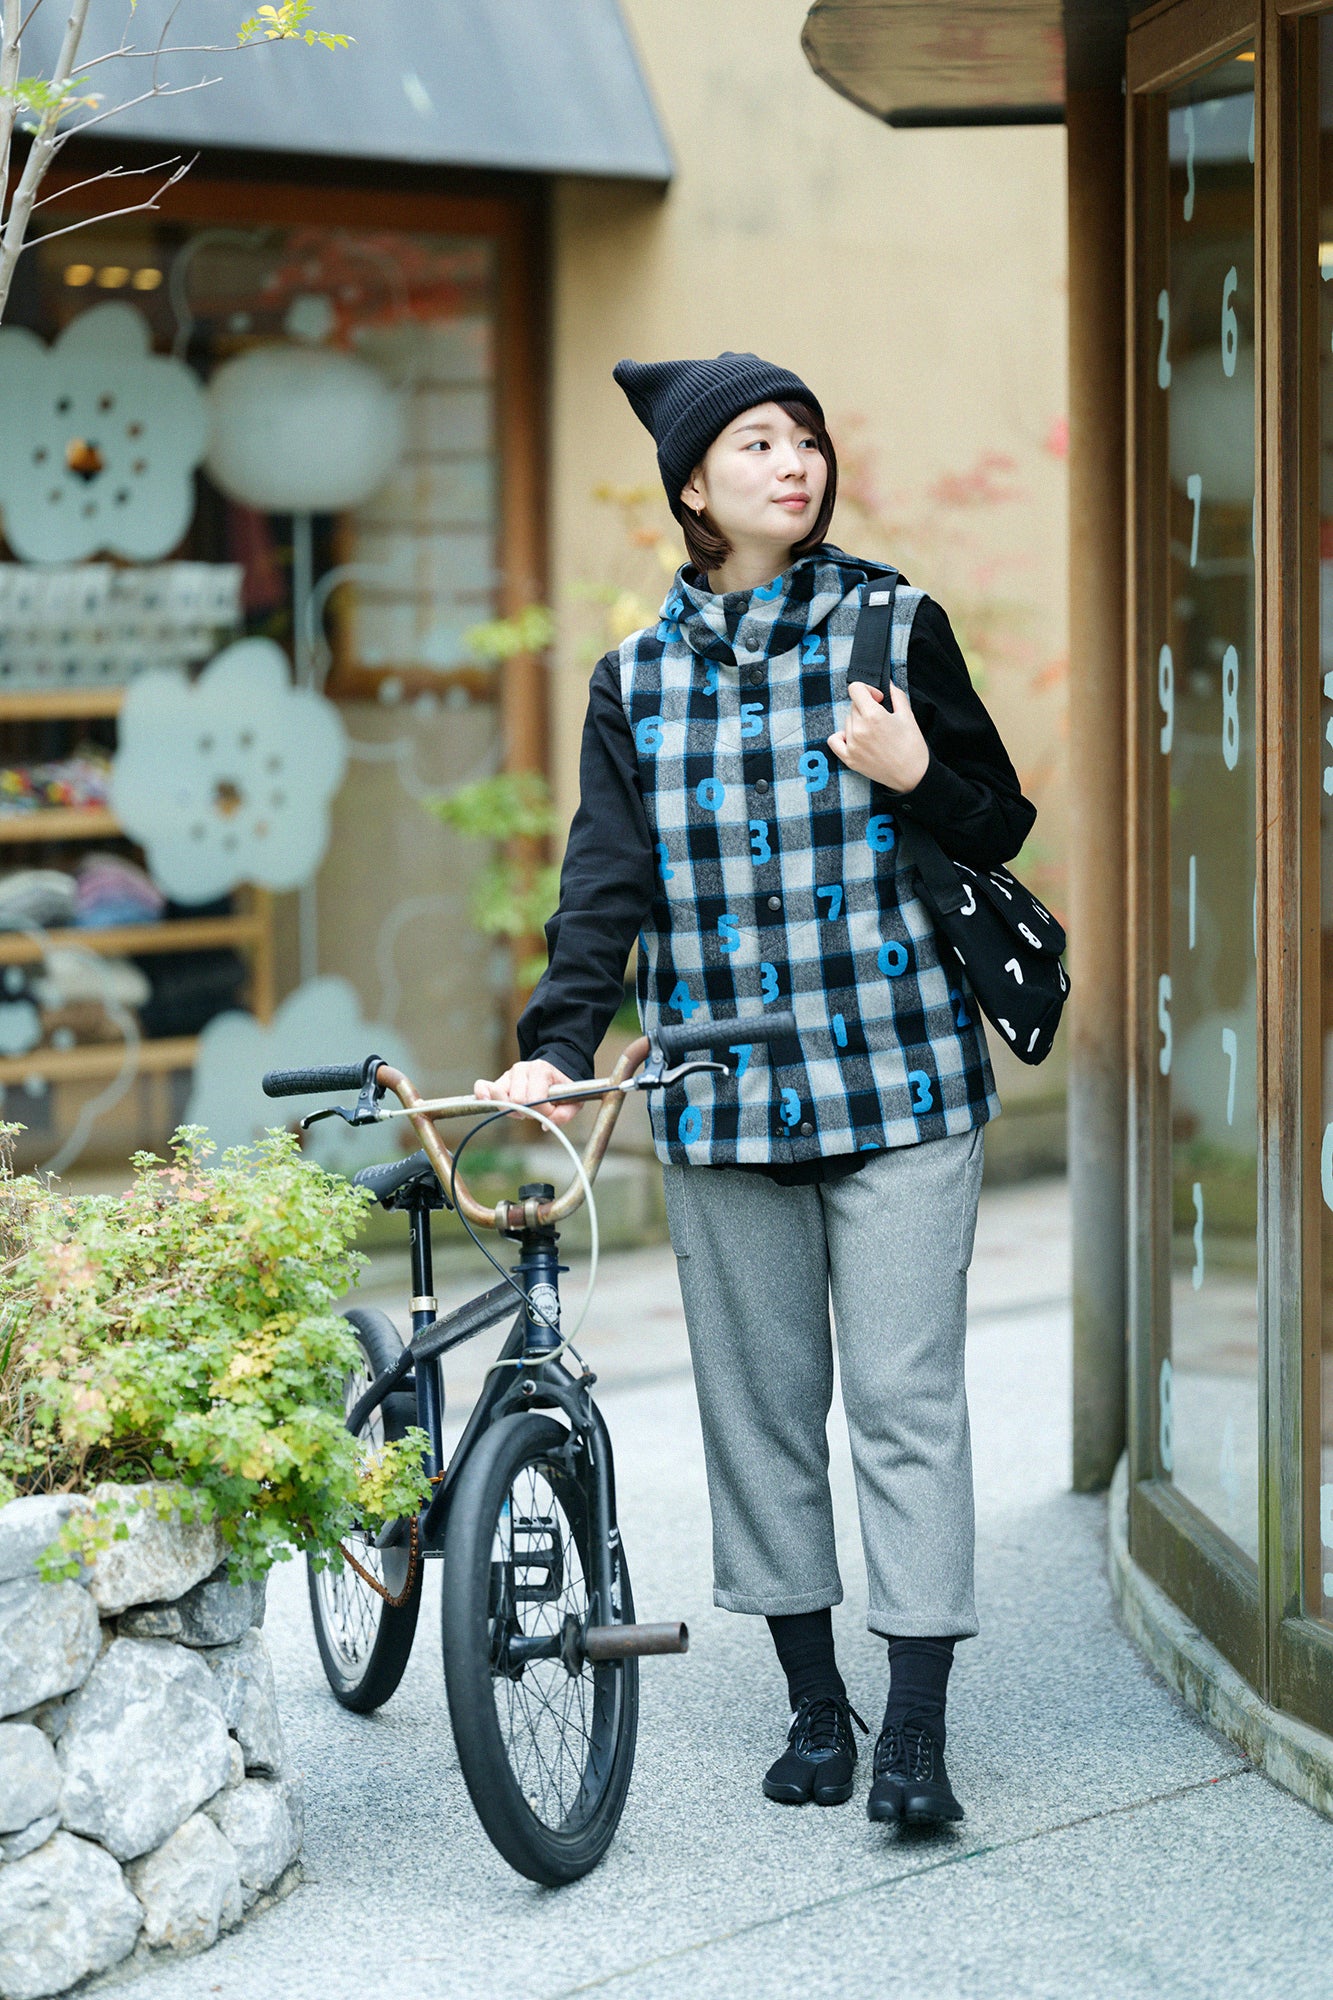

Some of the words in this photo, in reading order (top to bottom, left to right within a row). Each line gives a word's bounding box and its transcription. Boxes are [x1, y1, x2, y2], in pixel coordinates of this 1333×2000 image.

[1221, 265, 1238, 377] 6
[1187, 473, 1202, 567] 7
[802, 634, 826, 665] 2
[1158, 643, 1174, 755] 9
[1222, 644, 1239, 771] 8
[635, 715, 664, 754] 6
[740, 702, 764, 738] 5
[799, 750, 830, 793] 9
[696, 777, 725, 812] 0
[750, 819, 772, 866] 3
[865, 813, 896, 853] 6
[816, 884, 844, 922] 7
[717, 913, 741, 954] 5
[1017, 922, 1043, 950] 8
[877, 940, 909, 978] 0
[1004, 957, 1024, 986] 7
[668, 980, 700, 1019] 4
[760, 962, 780, 1005] 3
[832, 1013, 849, 1049] 1
[1158, 973, 1172, 1076] 5
[728, 1043, 754, 1078] 7
[1222, 1027, 1237, 1126] 7
[908, 1069, 934, 1115] 3
[678, 1105, 703, 1146] 0
[1159, 1356, 1173, 1473] 8
